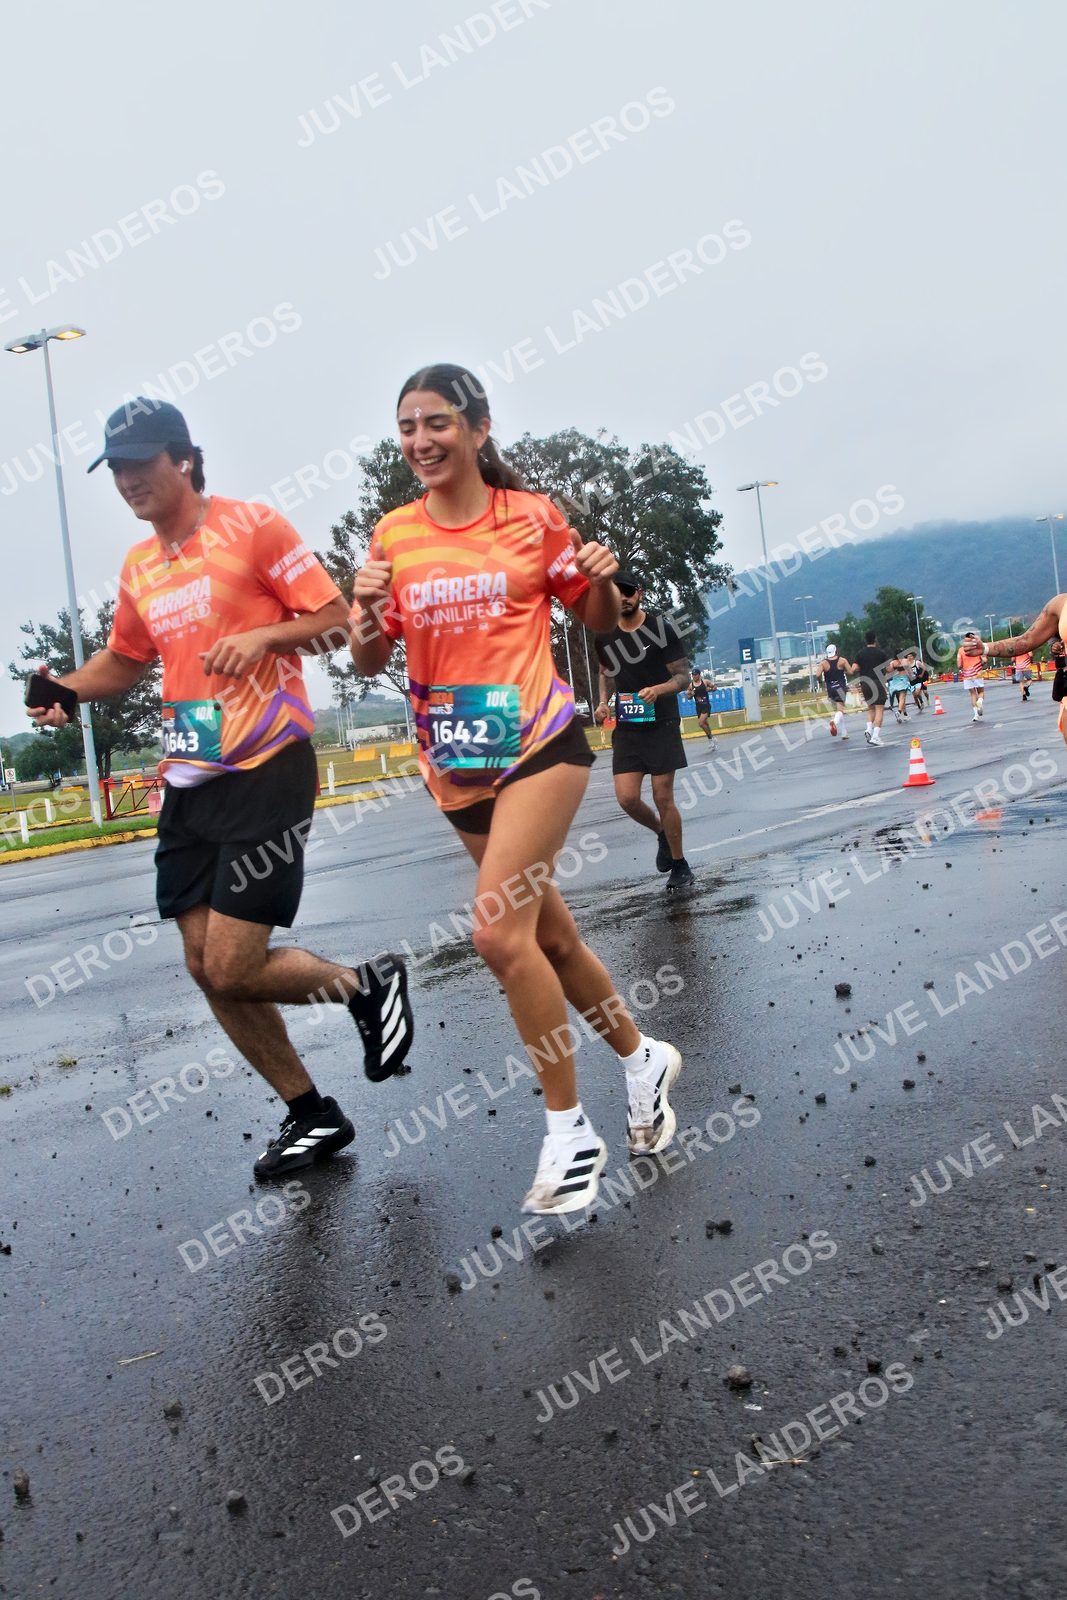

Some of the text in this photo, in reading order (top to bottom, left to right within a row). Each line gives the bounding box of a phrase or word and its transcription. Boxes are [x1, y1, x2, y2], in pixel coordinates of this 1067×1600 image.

[148, 575, 212, 621] CARRERA
[409, 571, 507, 610] CARRERA
[412, 602, 486, 629] OMNILIFE
[742, 648, 752, 661] E
[486, 691, 508, 707] 10K
[623, 704, 645, 714] 1273
[164, 731, 199, 753] 1643
[432, 720, 488, 744] 1642
